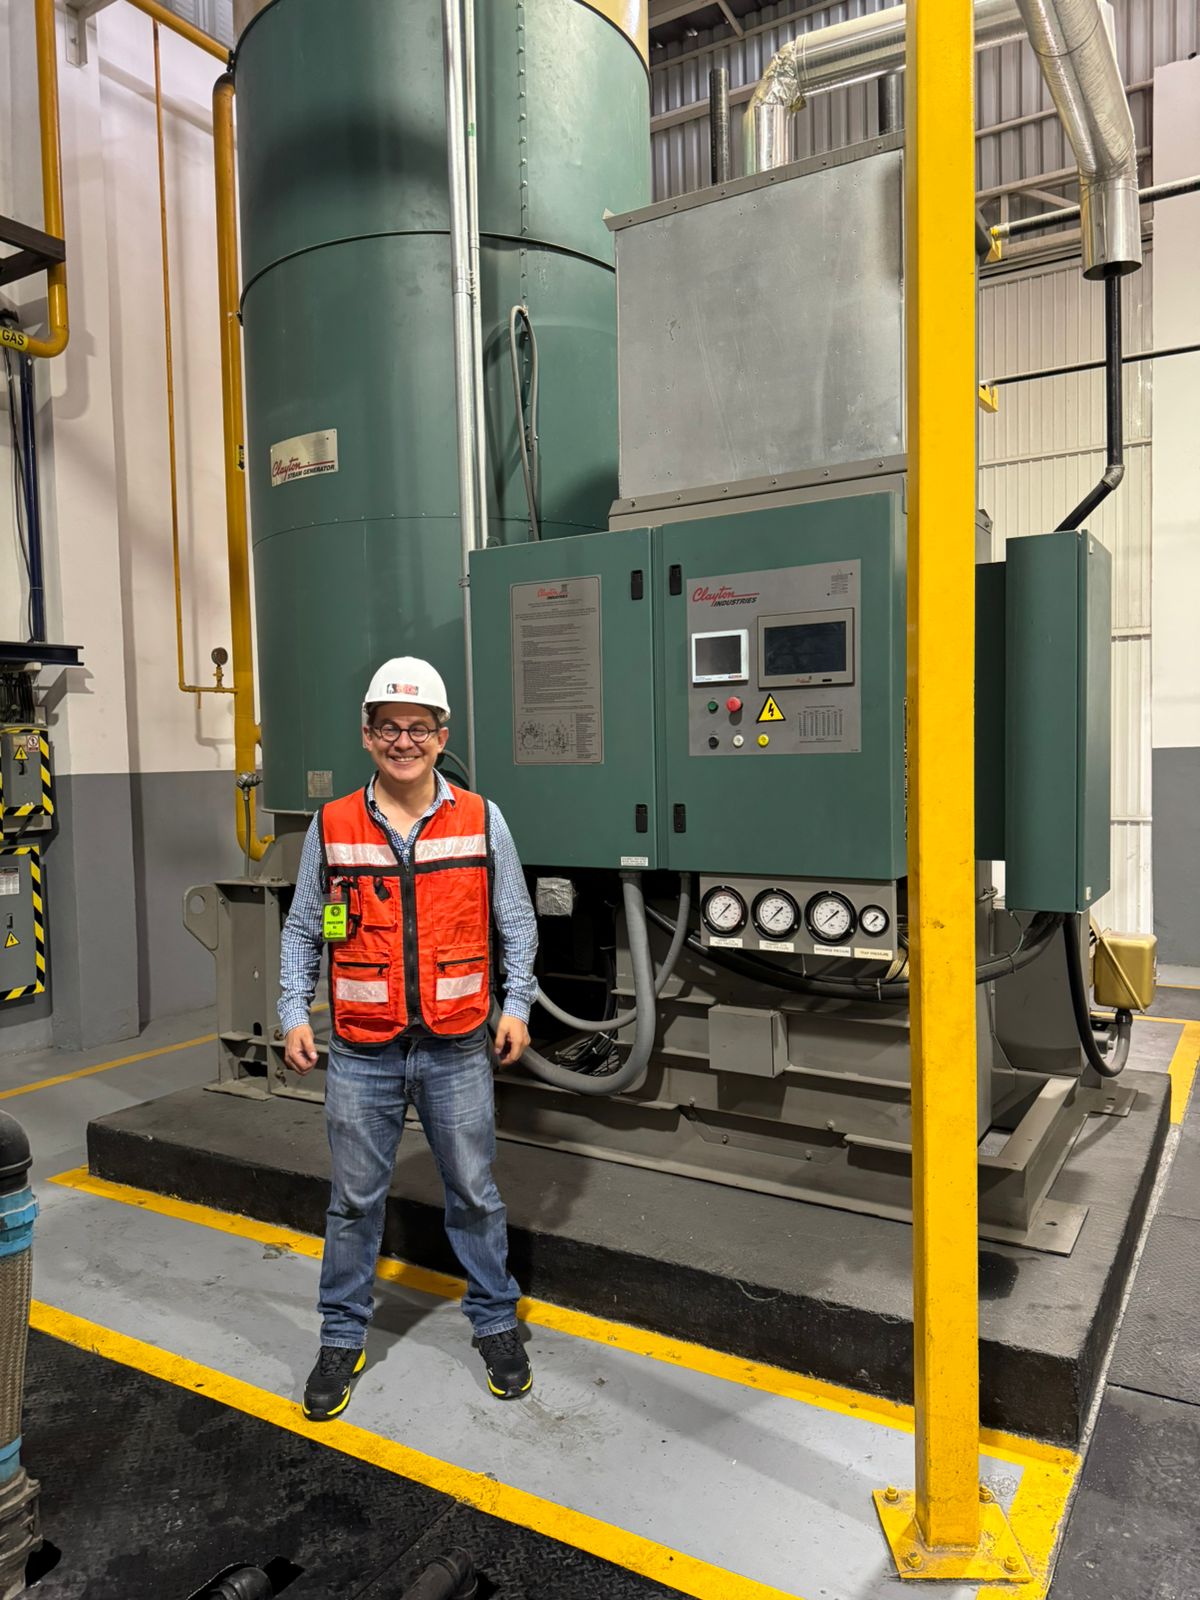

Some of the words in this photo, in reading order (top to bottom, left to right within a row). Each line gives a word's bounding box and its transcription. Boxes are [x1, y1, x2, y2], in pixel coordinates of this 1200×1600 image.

[2, 329, 25, 346] GAS
[303, 465, 335, 475] GENERATOR
[692, 586, 736, 606] Clayton
[714, 597, 757, 607] INDUSTRIES
